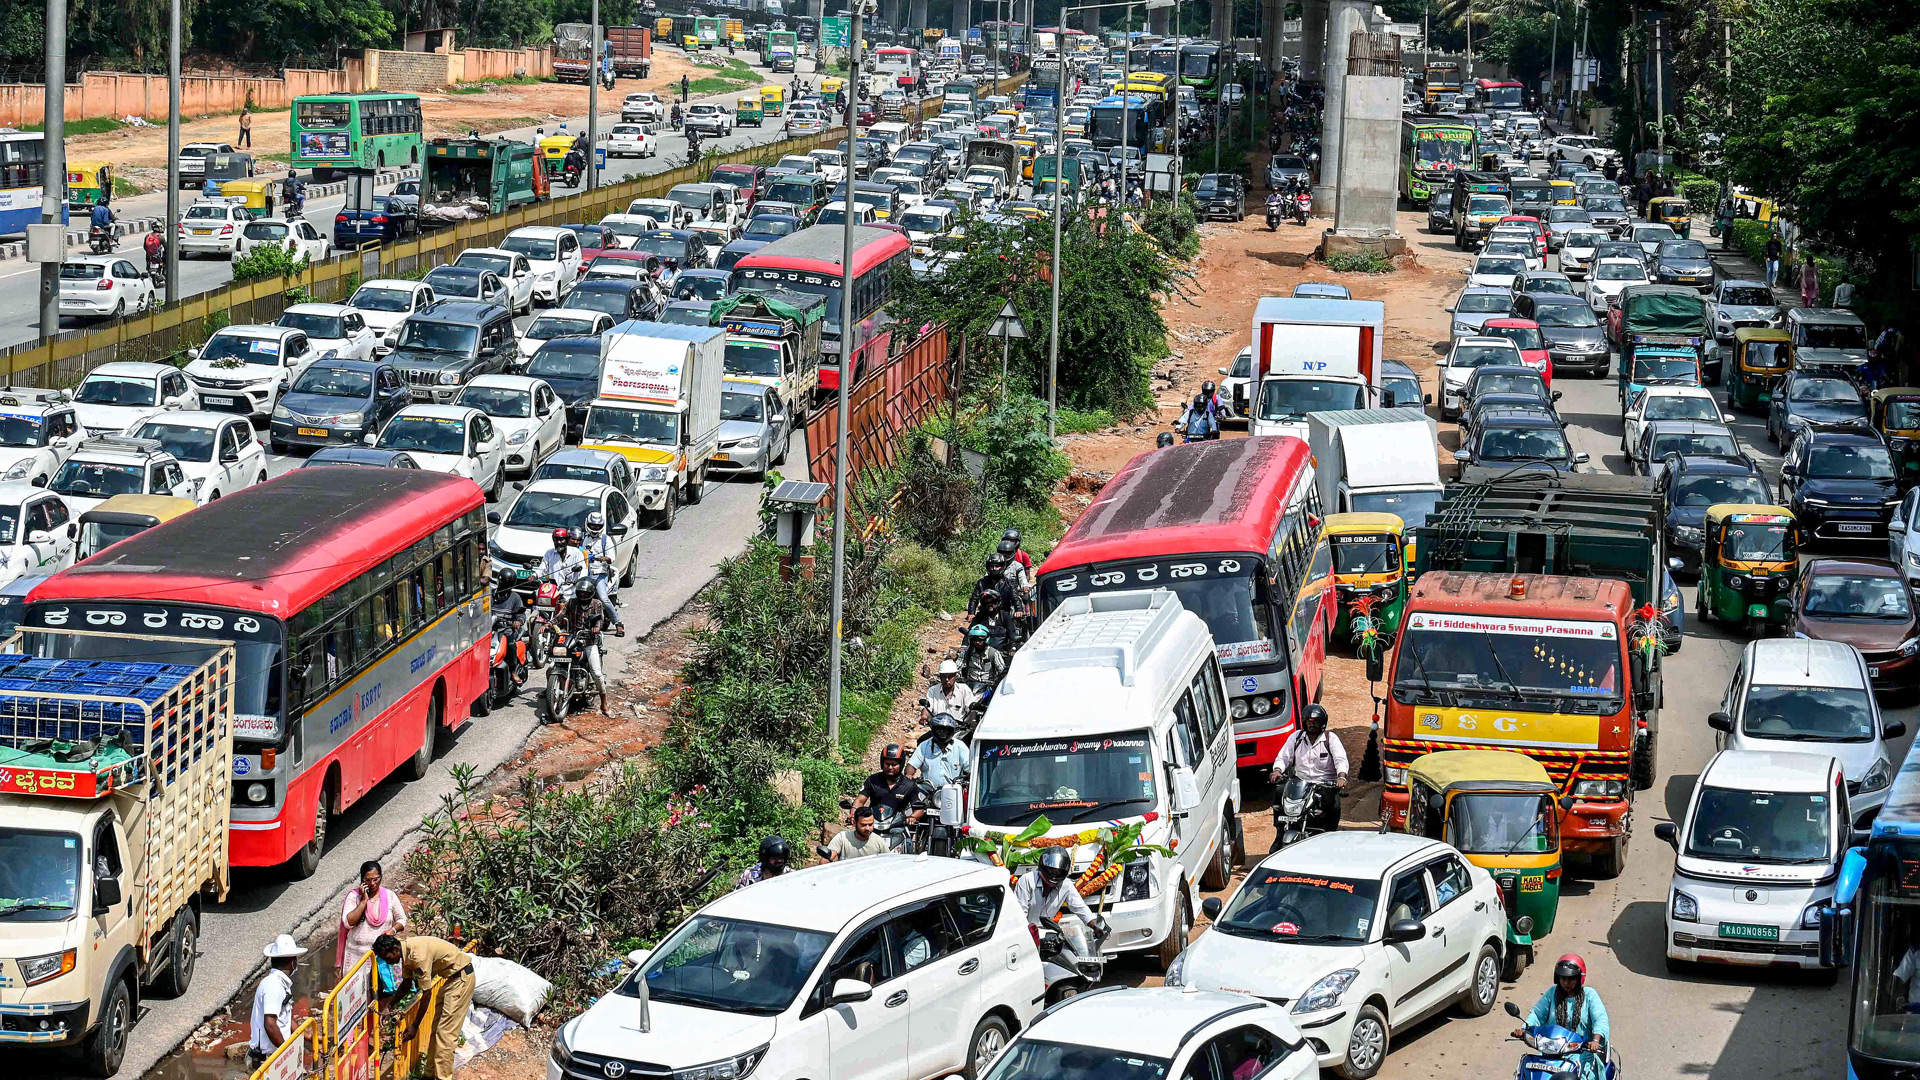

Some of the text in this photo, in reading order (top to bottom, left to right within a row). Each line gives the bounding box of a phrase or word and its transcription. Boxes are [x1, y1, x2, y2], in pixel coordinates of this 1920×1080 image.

[612, 380, 670, 392] PROFESSIONAL
[1428, 619, 1594, 636] Sri Siddeshwara Swamy Prasanna
[361, 682, 382, 711] KSRTC
[1570, 685, 1598, 694] BBMP
[999, 742, 1068, 757] Nanjundeshwara
[1069, 740, 1101, 753] Swamy
[1103, 738, 1145, 750] Prasanna
